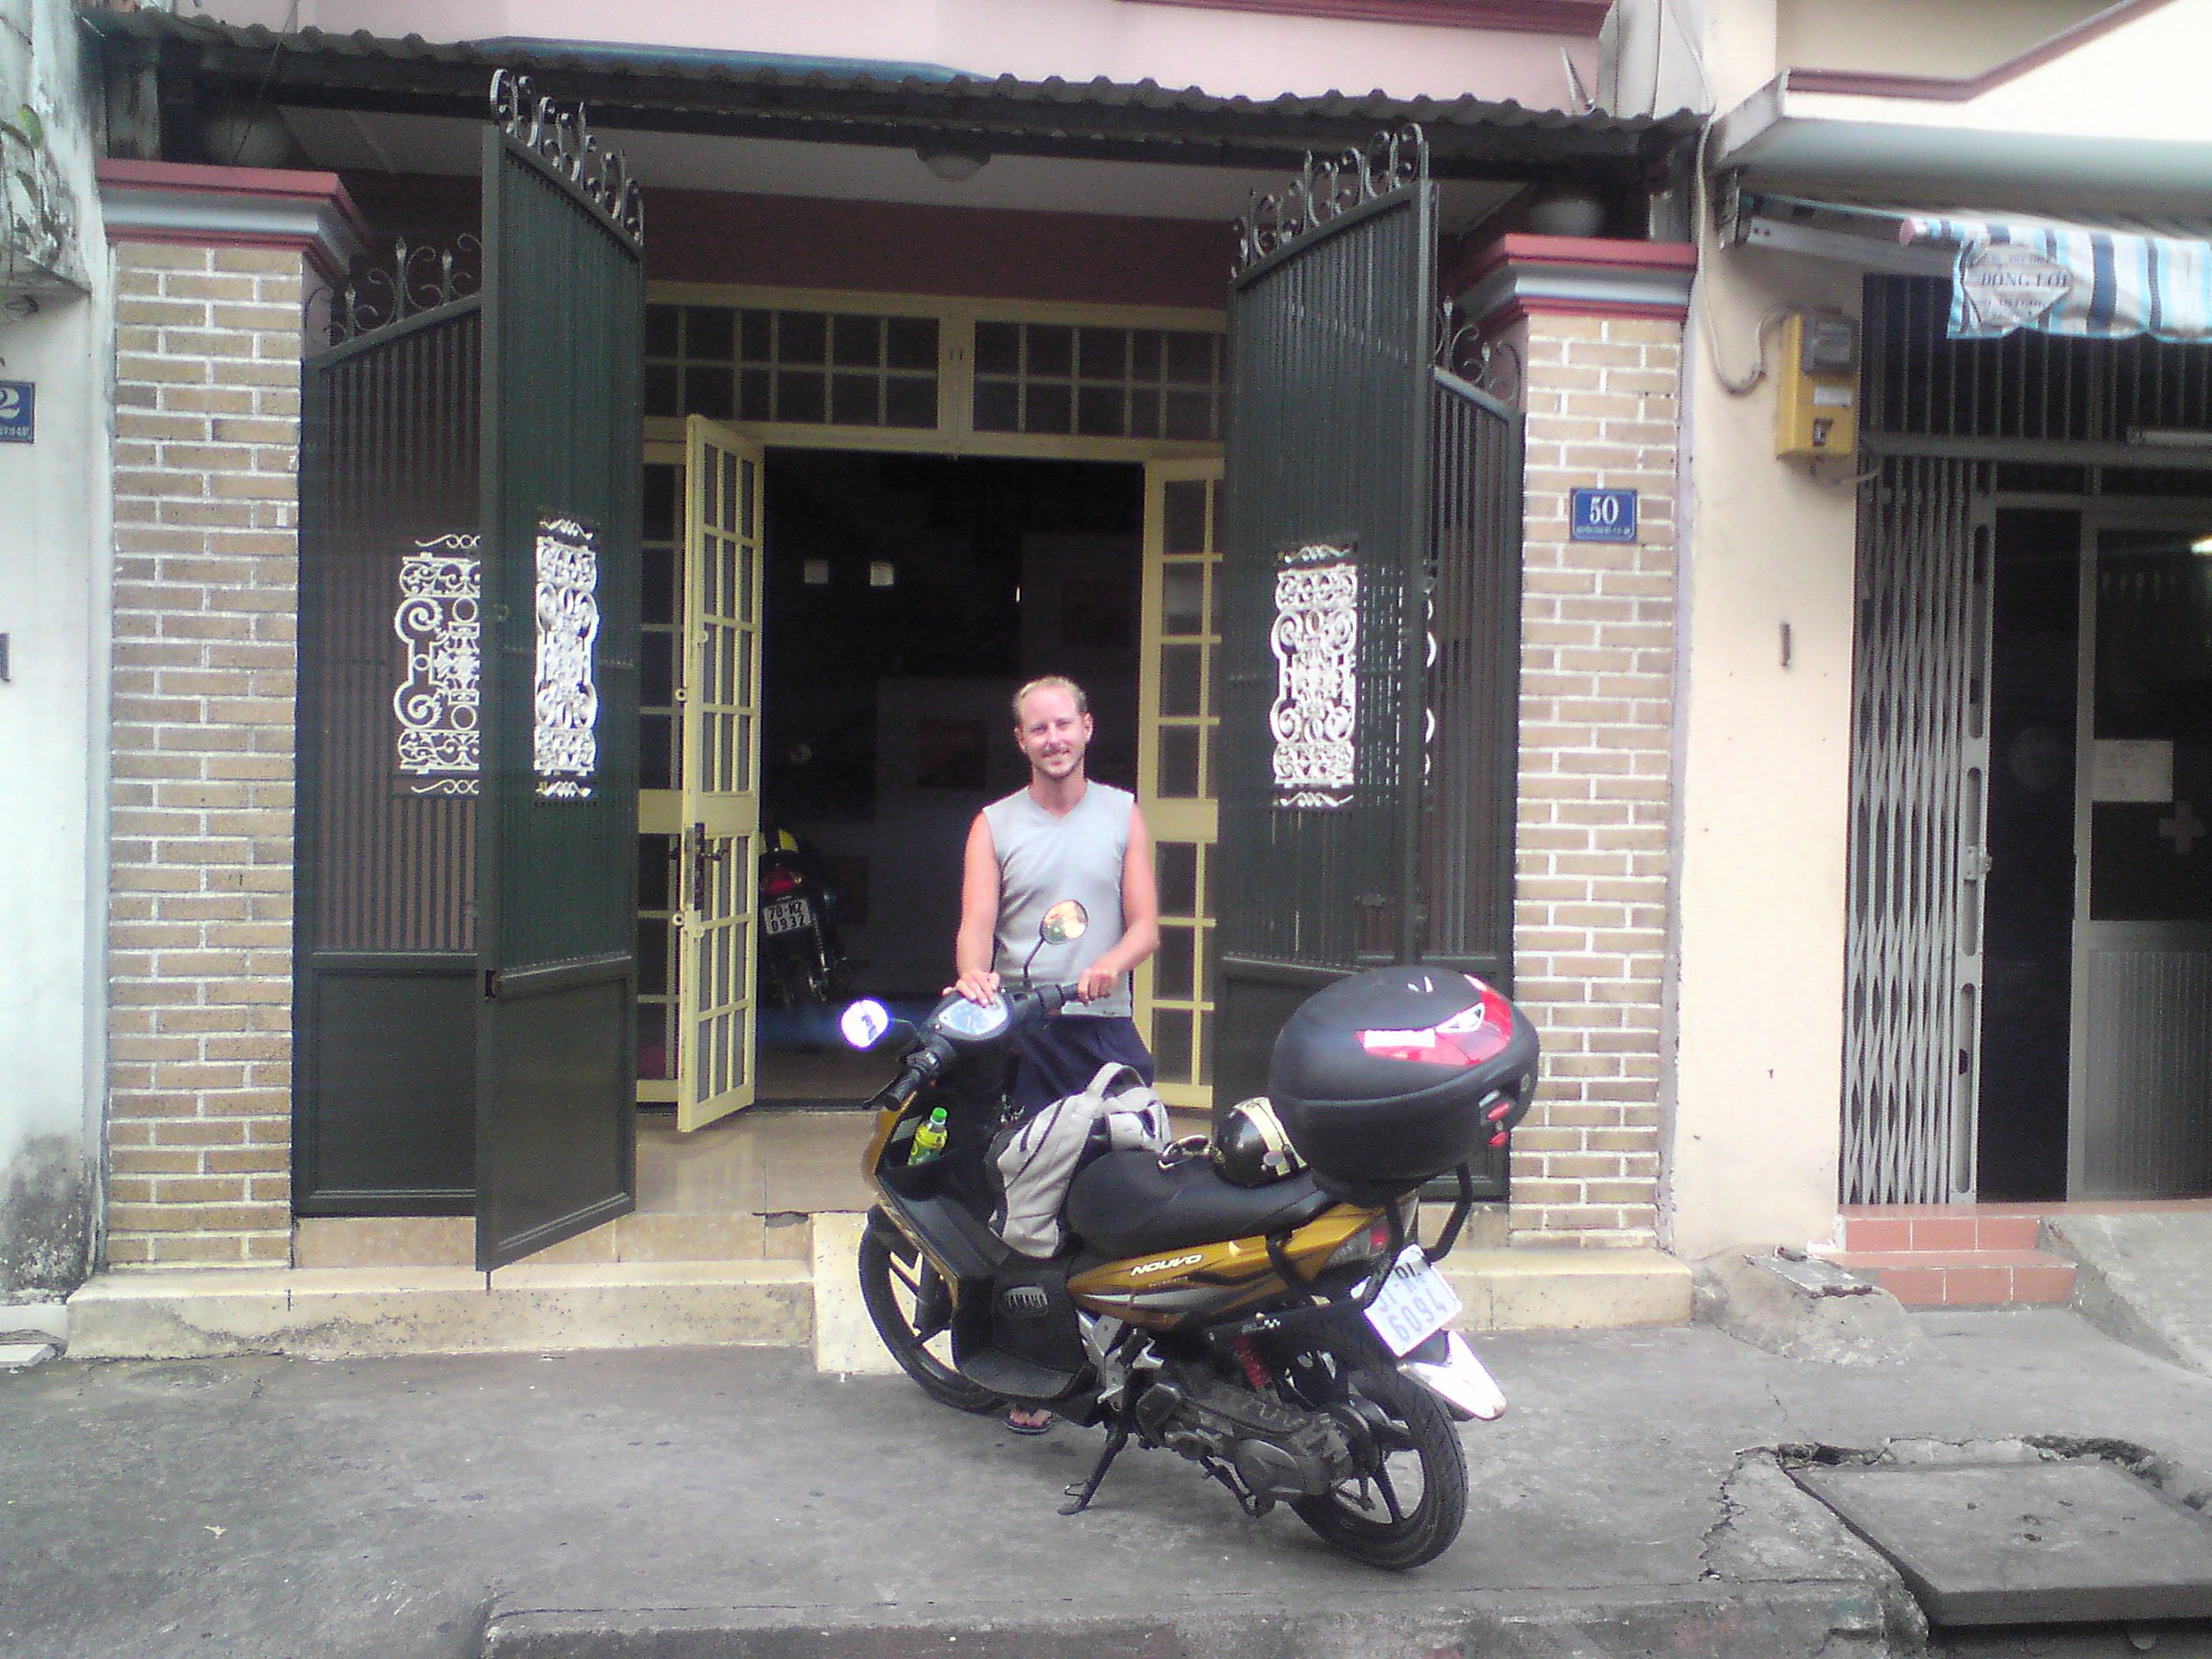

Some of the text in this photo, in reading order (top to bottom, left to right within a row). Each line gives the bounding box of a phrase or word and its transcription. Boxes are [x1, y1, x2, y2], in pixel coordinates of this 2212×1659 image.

[1589, 495, 1618, 525] 50
[1130, 1254, 1204, 1277] NOUVO
[1387, 1287, 1448, 1341] 6094
